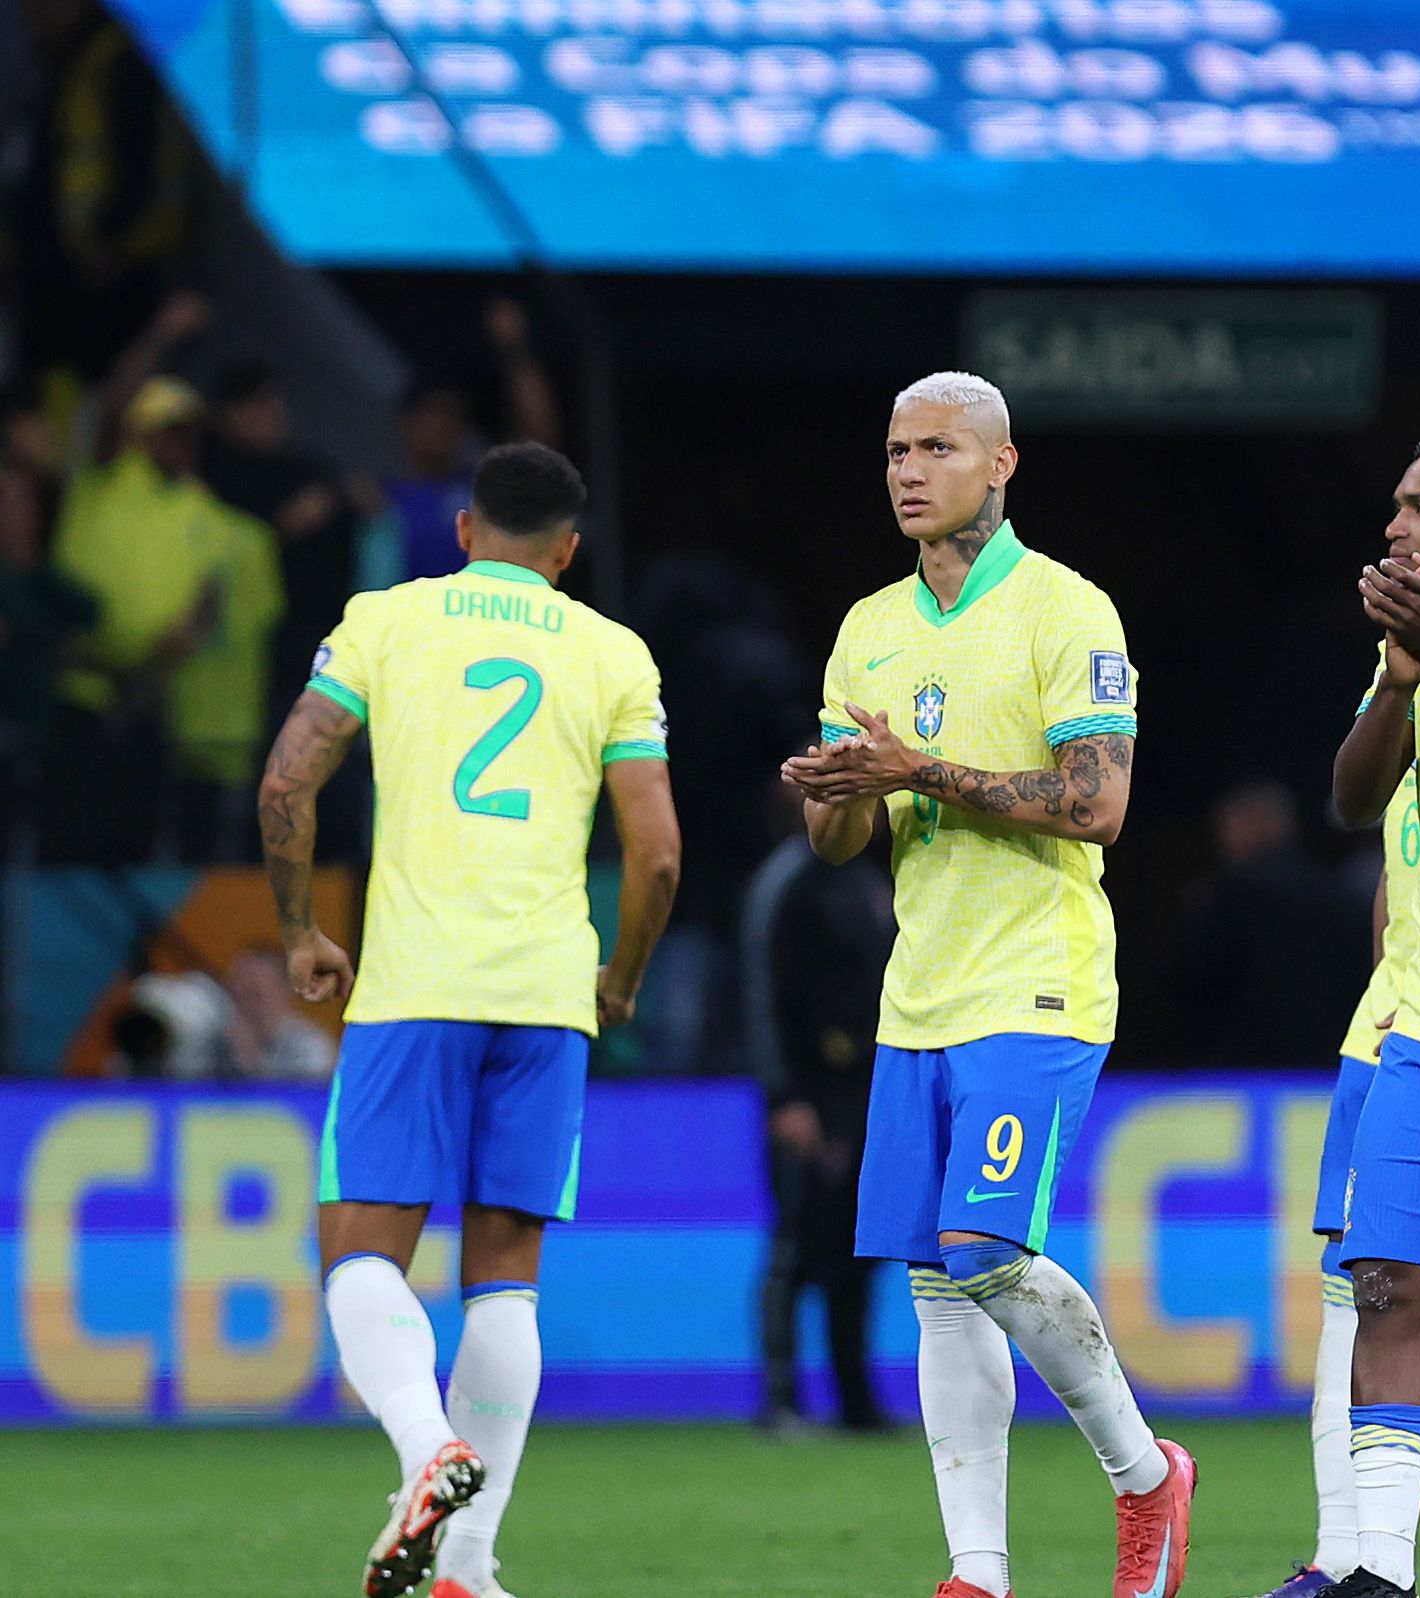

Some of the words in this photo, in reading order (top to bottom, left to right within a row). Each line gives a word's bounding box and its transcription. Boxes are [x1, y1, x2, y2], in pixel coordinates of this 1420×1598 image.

[544, 35, 937, 98] Copa
[962, 38, 1168, 100] do
[582, 97, 942, 162] FIFA
[444, 588, 565, 634] DANILO
[453, 657, 544, 820] 2
[981, 1113, 1024, 1182] 9
